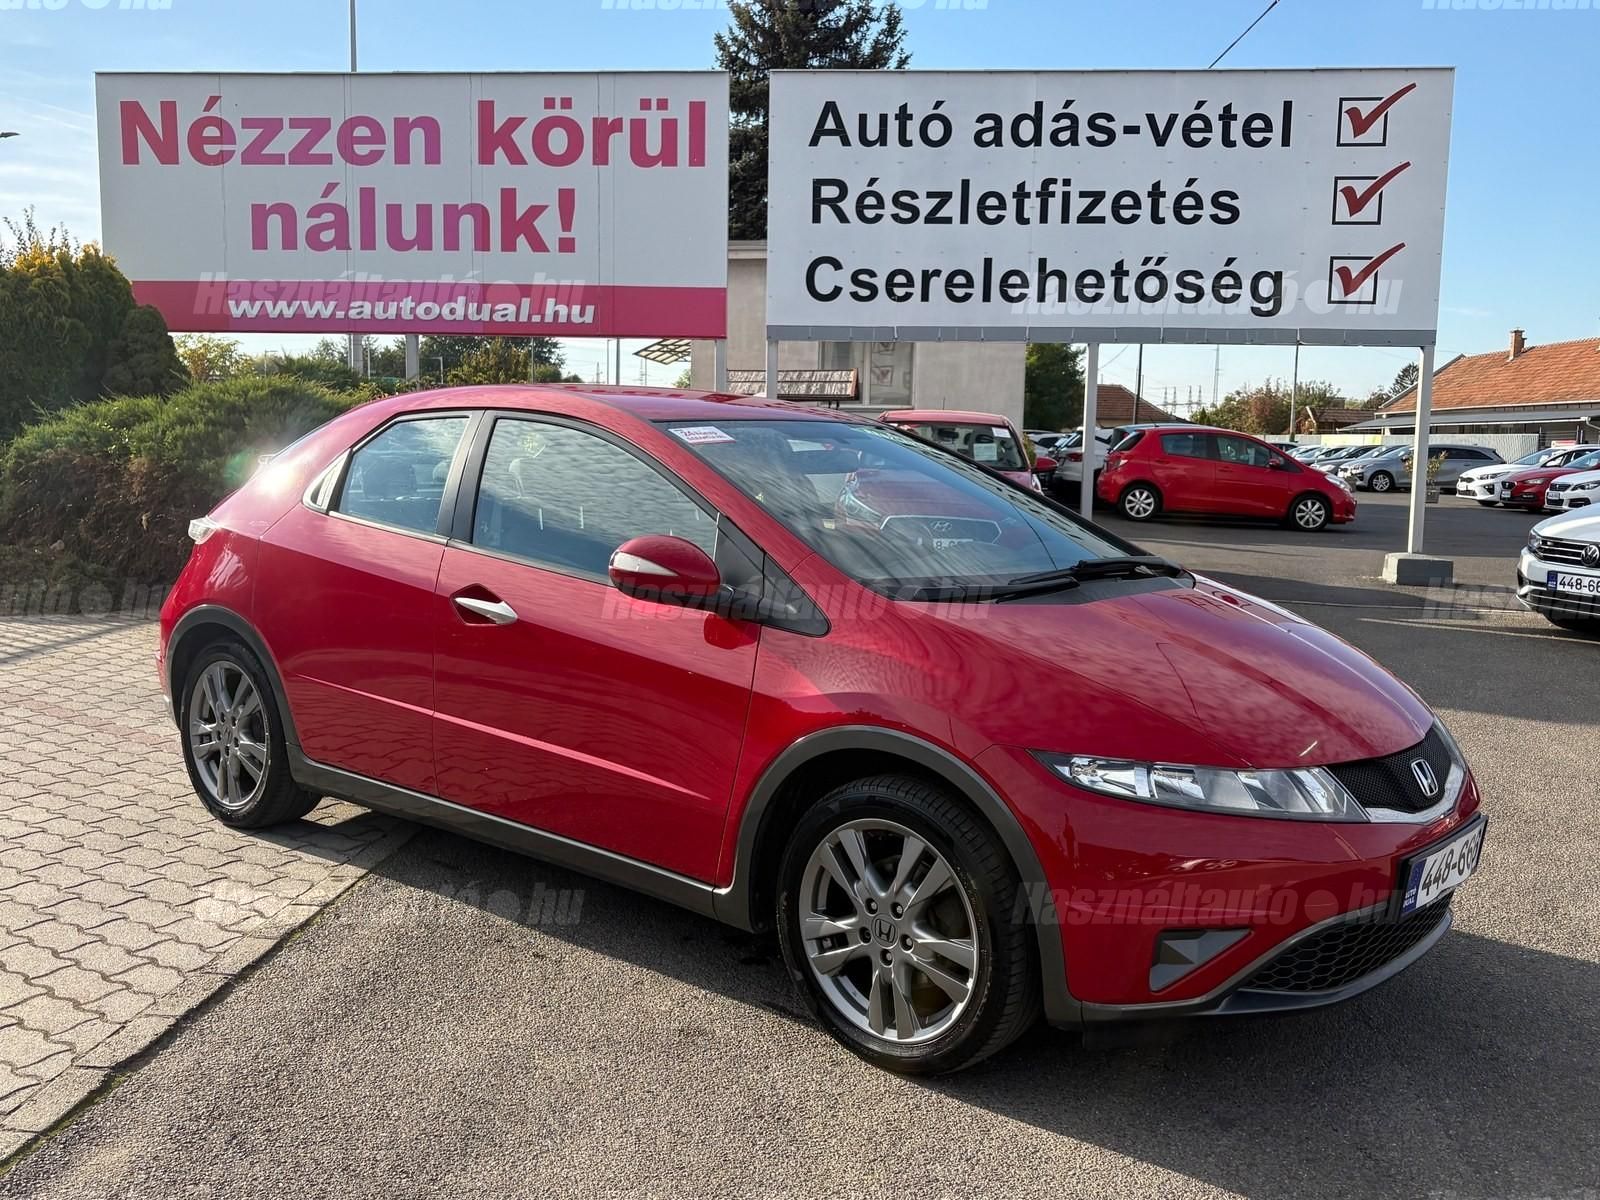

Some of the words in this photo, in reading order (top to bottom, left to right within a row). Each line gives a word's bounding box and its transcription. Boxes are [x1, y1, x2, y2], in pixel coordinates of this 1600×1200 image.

[121, 96, 440, 166] Nézzen
[478, 97, 706, 168] körül
[809, 100, 952, 148] Autó
[973, 99, 1292, 149] adás-vétel
[251, 183, 577, 252] nálunk!
[811, 178, 1240, 226] Részletfizetés
[228, 295, 595, 324] www.autodual.hu
[805, 255, 1283, 317] Cserelehetőség
